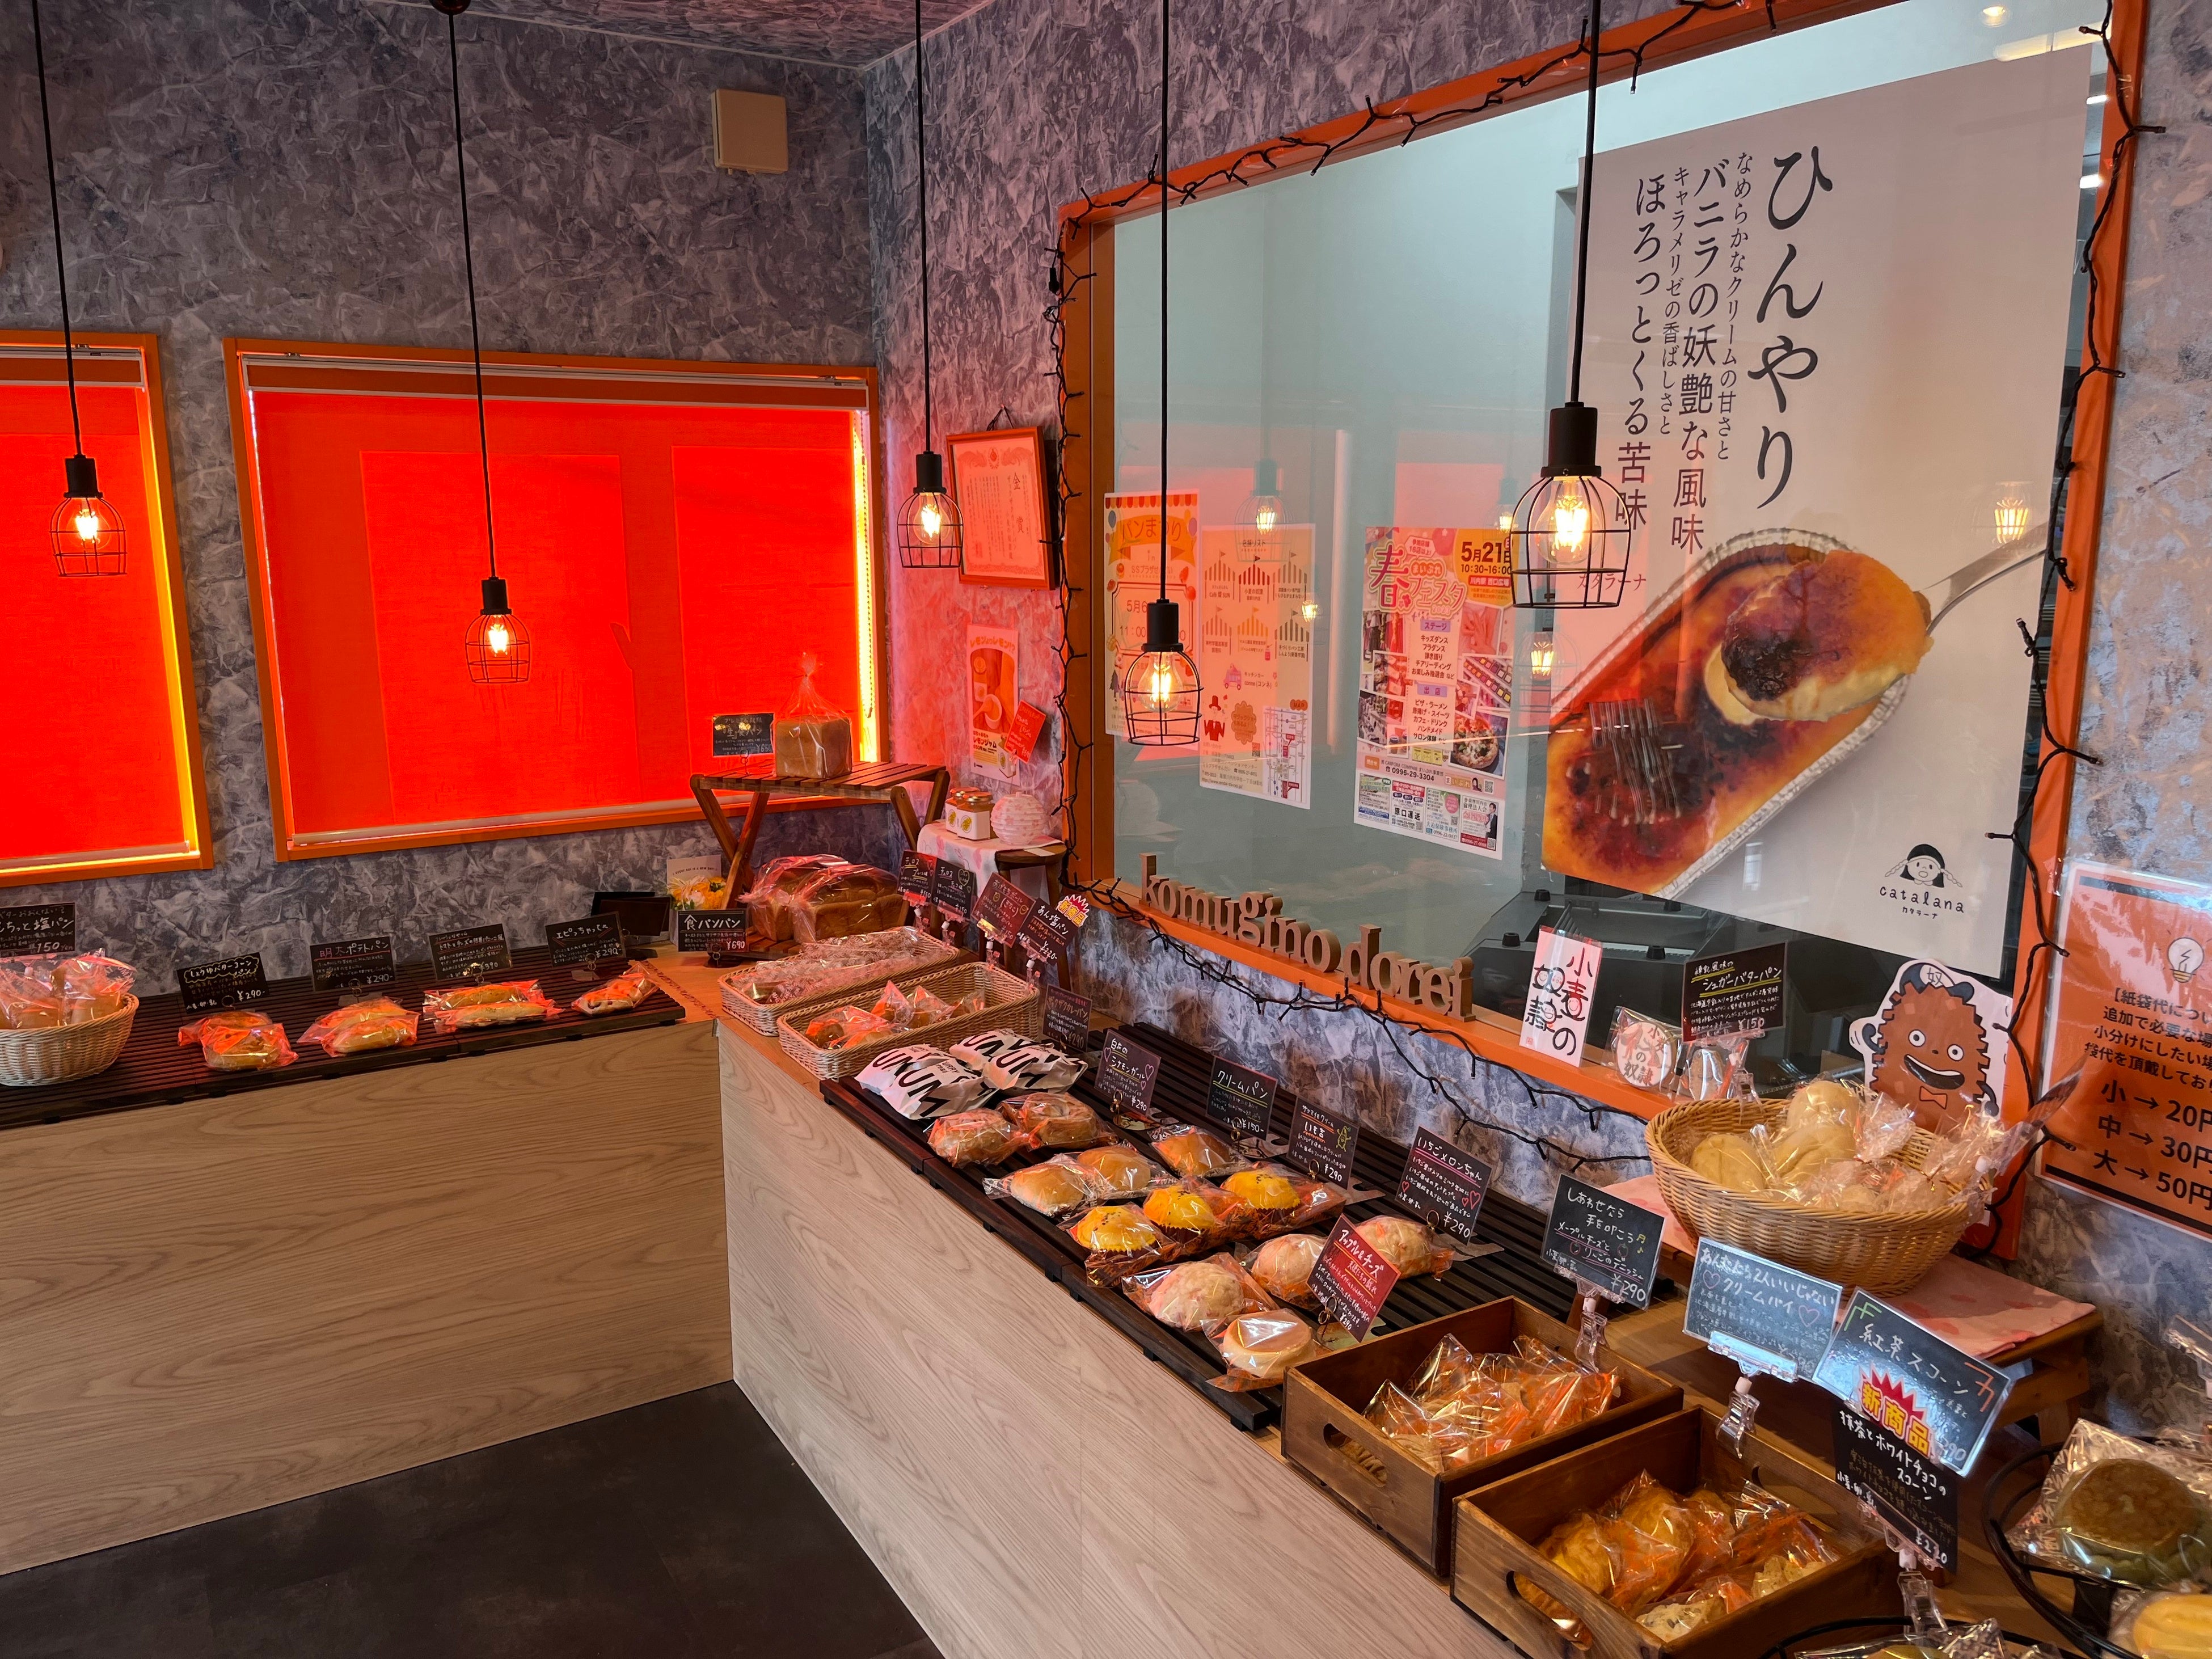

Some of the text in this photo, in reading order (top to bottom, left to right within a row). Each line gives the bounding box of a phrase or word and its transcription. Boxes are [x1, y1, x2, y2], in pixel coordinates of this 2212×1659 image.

[1659, 166, 1690, 435] キャラメリゼの香ばしさと
[1717, 151, 1753, 460] なめらかなクリームの甘さと
[1747, 146, 1833, 510] ひんやり
[1615, 174, 1665, 531] ほろっとくる苦味
[1670, 158, 1729, 555] バニラの妖艶な風味
[1460, 541, 1511, 564] 5月21日
[1370, 543, 1410, 608] 春
[1408, 577, 1464, 609] フェスタ
[1424, 622, 1447, 631] ステージ
[1420, 635, 1449, 644] キッズダンス
[1422, 644, 1446, 652] フラダンス
[1416, 660, 1452, 670] チアリーディング
[973, 737, 997, 748] レモンジャム
[1417, 725, 1443, 735] ハンドメイド
[1391, 767, 1435, 782] 0996-29-3304
[1879, 886, 1964, 913] catalana
[683, 914, 741, 931] 食パンパン
[1037, 904, 1070, 935] あん塩パン
[1058, 899, 1083, 926] 新商品
[1902, 906, 1938, 919] カタラーナ
[1001, 925, 1013, 940] ¥150
[37, 942, 61, 953] 150
[726, 940, 746, 951] ¥690
[1703, 966, 1782, 991] シュガーバターパン
[1926, 967, 1944, 986] 奴
[1738, 1017, 1765, 1031] ¥150
[1068, 1031, 1084, 1049] ¥290
[1111, 1055, 1146, 1079] シナモンガール
[1217, 1070, 1268, 1099] クリームパン
[2101, 1079, 2126, 1103] 小
[1131, 1095, 1147, 1112] ¥290
[1304, 1121, 1326, 1139] いも吉
[2098, 1114, 2122, 1139] 中
[1417, 1136, 1483, 1181] いちごメロンちゃん
[1324, 1163, 1343, 1182] ¥290
[2093, 1149, 2212, 1211] 大 50円
[1567, 1187, 1625, 1219] しあわせなら
[1443, 1210, 1471, 1239] ¥290
[1557, 1221, 1610, 1252] メープルチーズと
[1585, 1213, 1634, 1243] 手を叩こう
[1338, 1229, 1384, 1279] アップル&チーズ
[1611, 1273, 1646, 1302] ¥290
[1339, 1312, 1353, 1331] ¥290
[1859, 1323, 1969, 1395] 紅茶スコーン
[1860, 1381, 1930, 1459] 新商品
[1839, 1410, 1947, 1496] 抹茶とホワイトチョコの
[1897, 1467, 1932, 1501] スコーン
